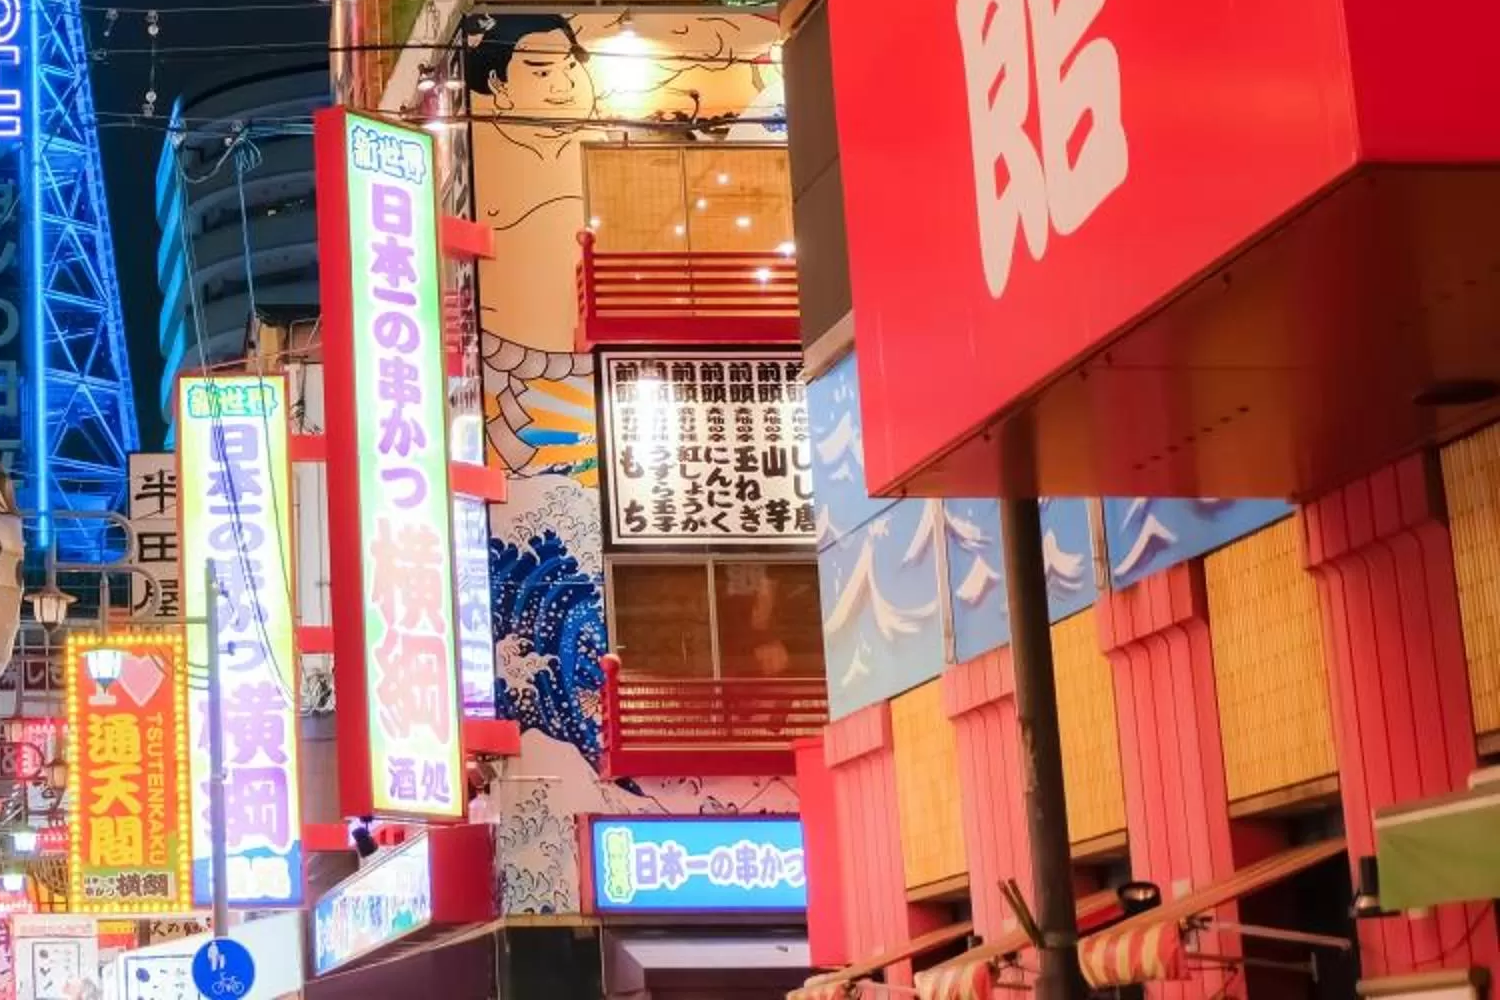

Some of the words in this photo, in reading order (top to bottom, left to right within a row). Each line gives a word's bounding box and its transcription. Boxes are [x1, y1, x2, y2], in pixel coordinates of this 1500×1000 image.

[371, 183, 428, 509] 日本一の串かつ
[620, 446, 647, 532] もち
[704, 446, 733, 532] にんにく
[734, 446, 763, 532] 玉ねぎ
[762, 446, 791, 532] 山芋
[370, 516, 449, 744] 横綱
[88, 713, 143, 867] 通天閣
[146, 711, 165, 865] TSUTENKAKU
[387, 755, 450, 804] 酒処
